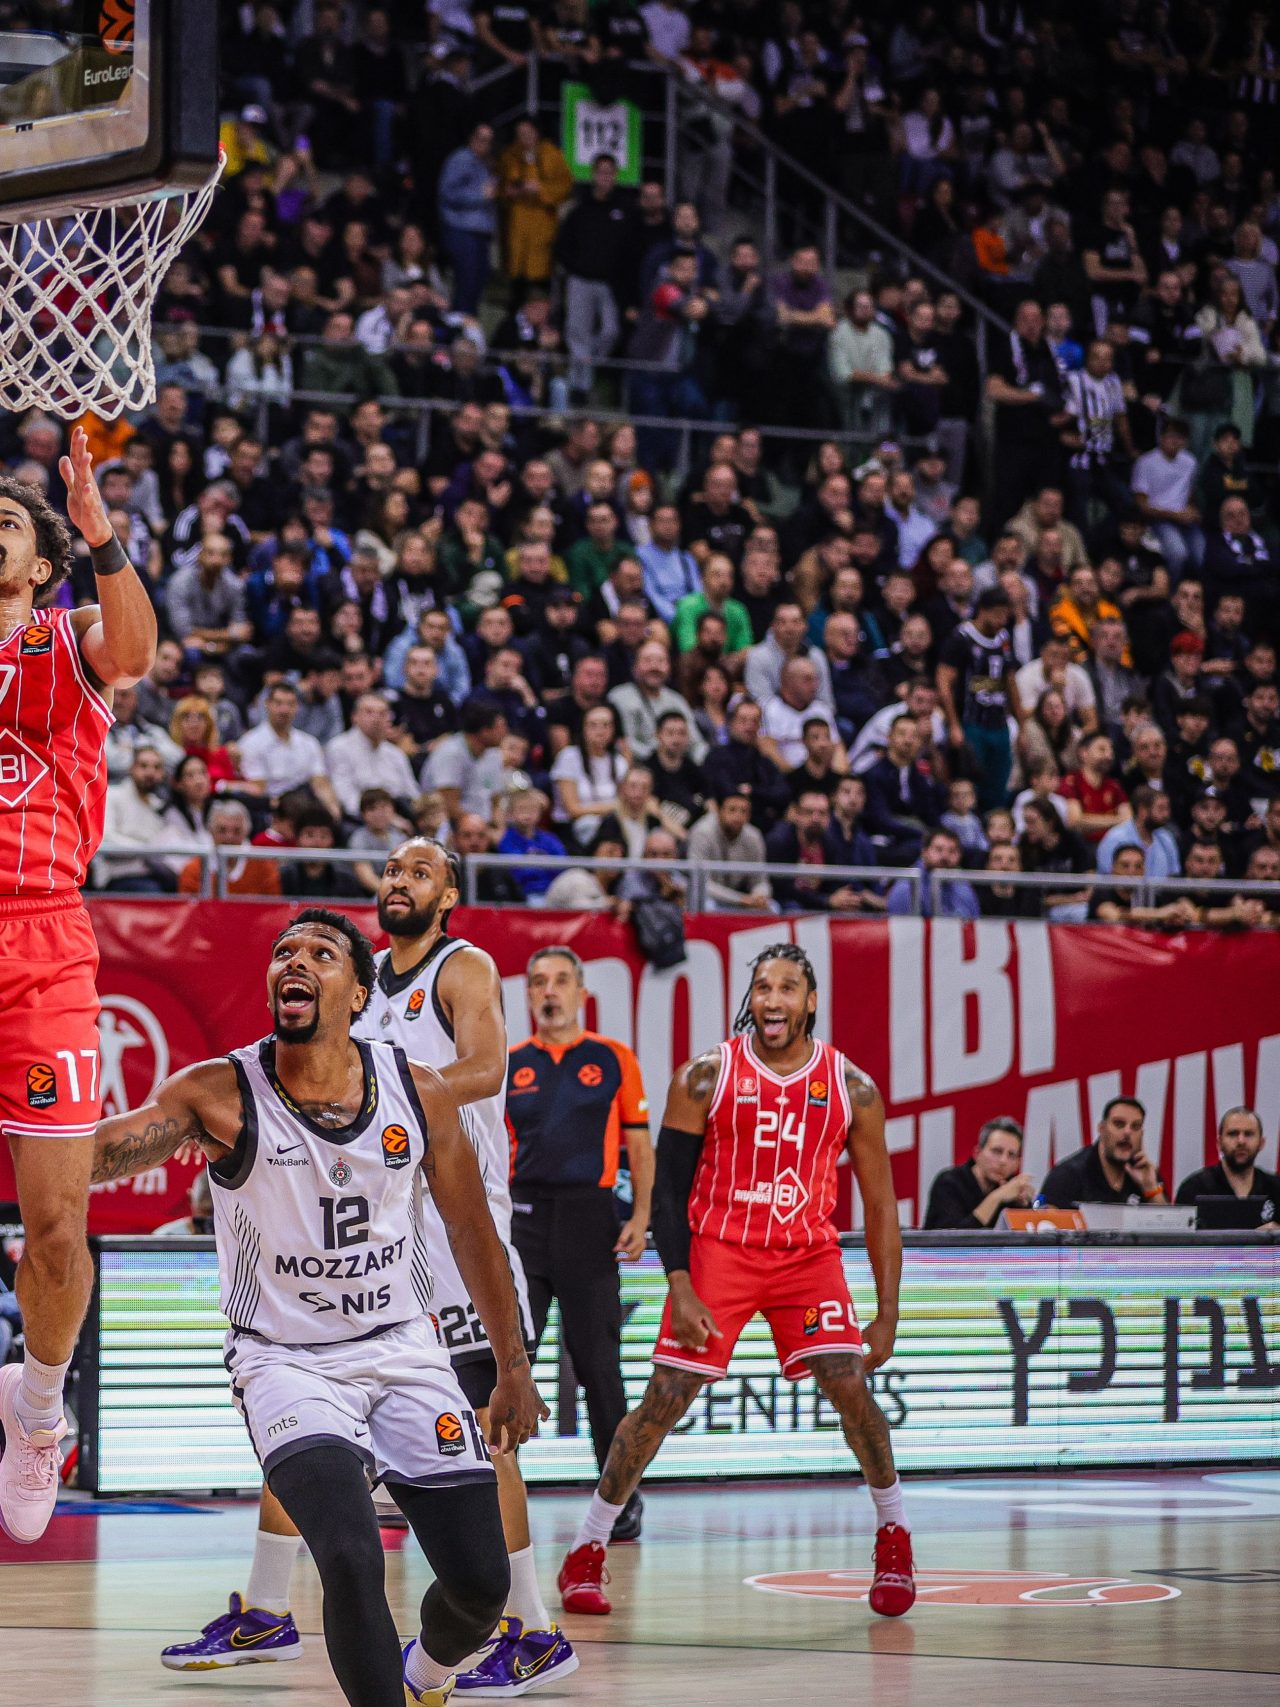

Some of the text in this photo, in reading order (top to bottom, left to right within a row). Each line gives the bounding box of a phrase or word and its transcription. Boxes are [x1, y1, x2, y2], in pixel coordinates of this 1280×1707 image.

[888, 917, 1055, 1104] IBI
[56, 1049, 98, 1102] 17
[754, 1110, 805, 1151] 24
[273, 1158, 310, 1167] AikBank
[319, 1195, 371, 1251] 12
[275, 1236, 407, 1280] MOZZART
[341, 1284, 392, 1316] NIS
[267, 1414, 299, 1439] mts
[461, 1410, 492, 1462] 1
